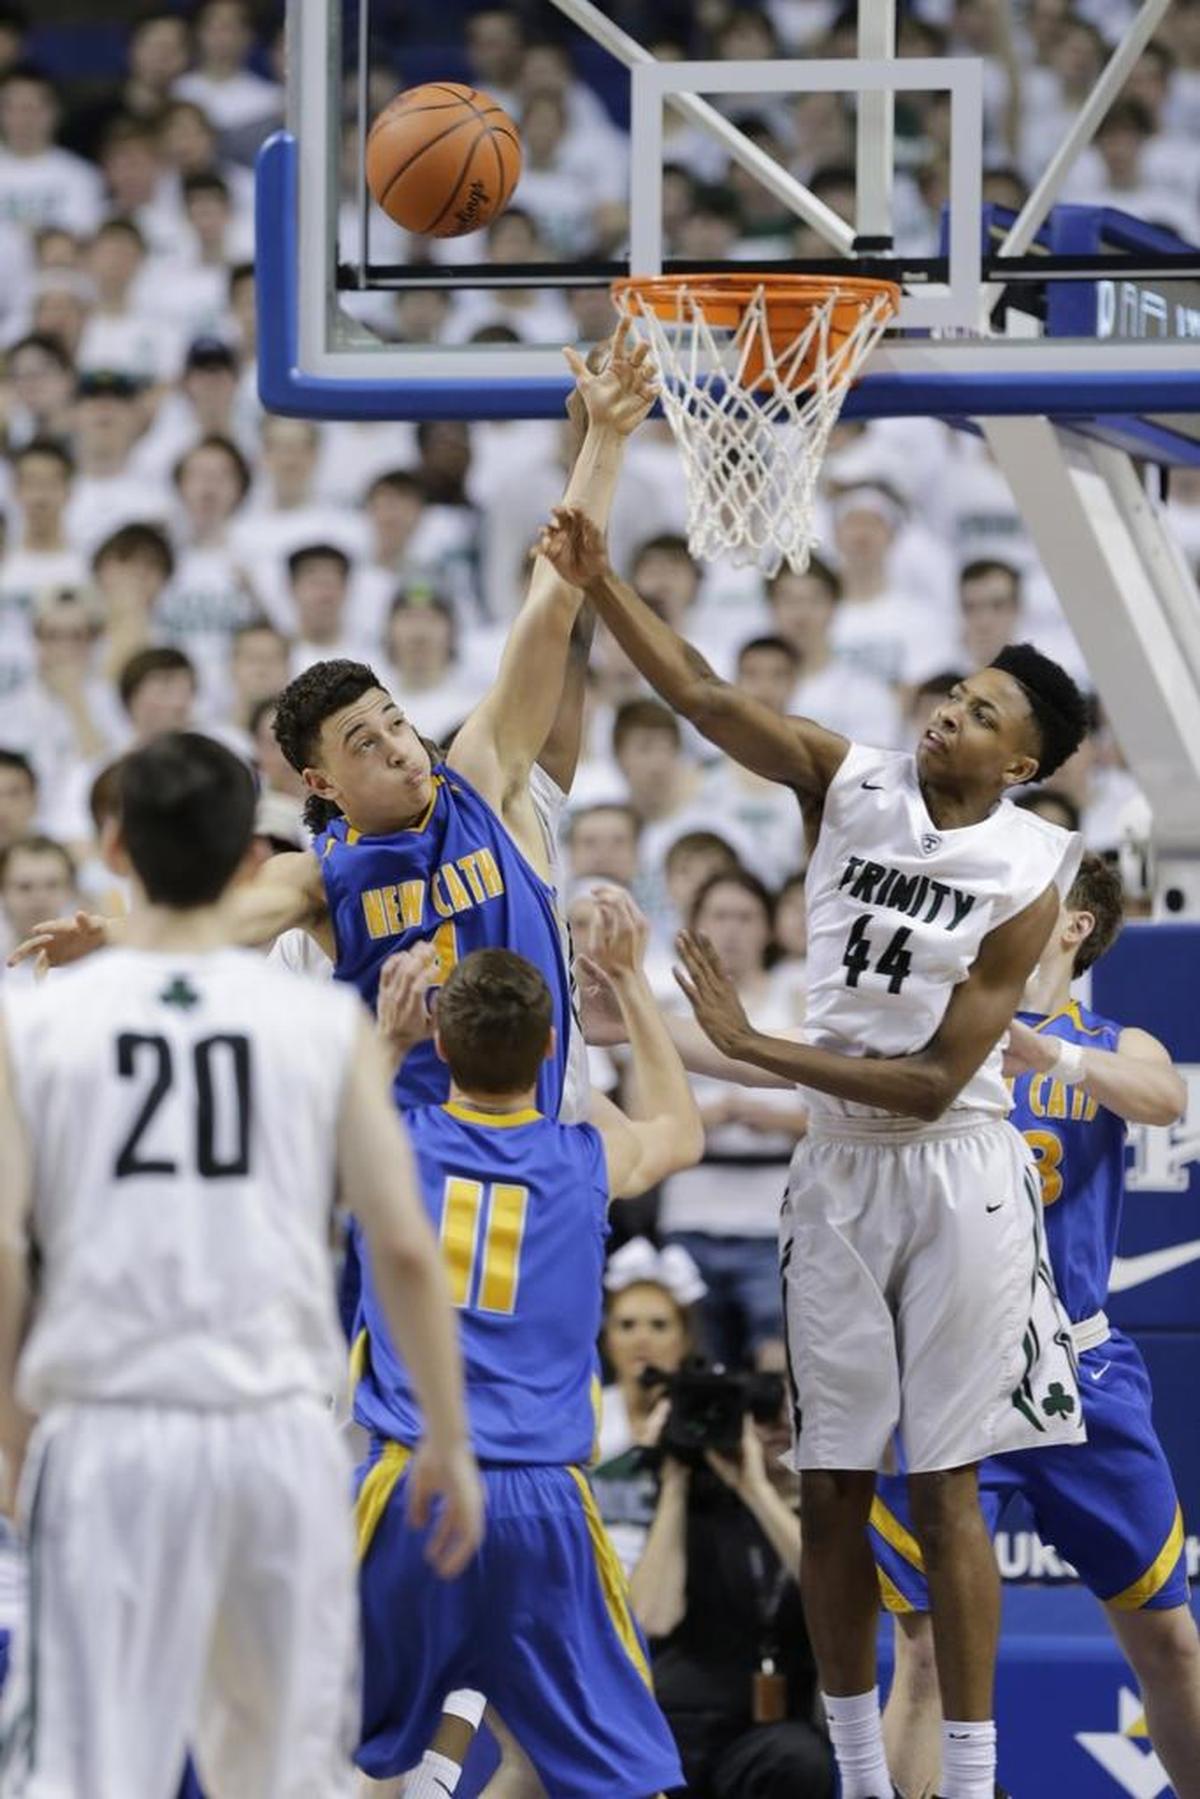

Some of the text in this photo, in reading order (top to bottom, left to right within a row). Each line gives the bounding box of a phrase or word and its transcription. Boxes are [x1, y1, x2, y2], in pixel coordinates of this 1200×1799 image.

[361, 847, 505, 940] NEW CATH
[838, 856, 977, 932] TRINITY
[843, 914, 914, 994] 44
[115, 1033, 249, 1178] 20
[440, 1175, 530, 1316] 11
